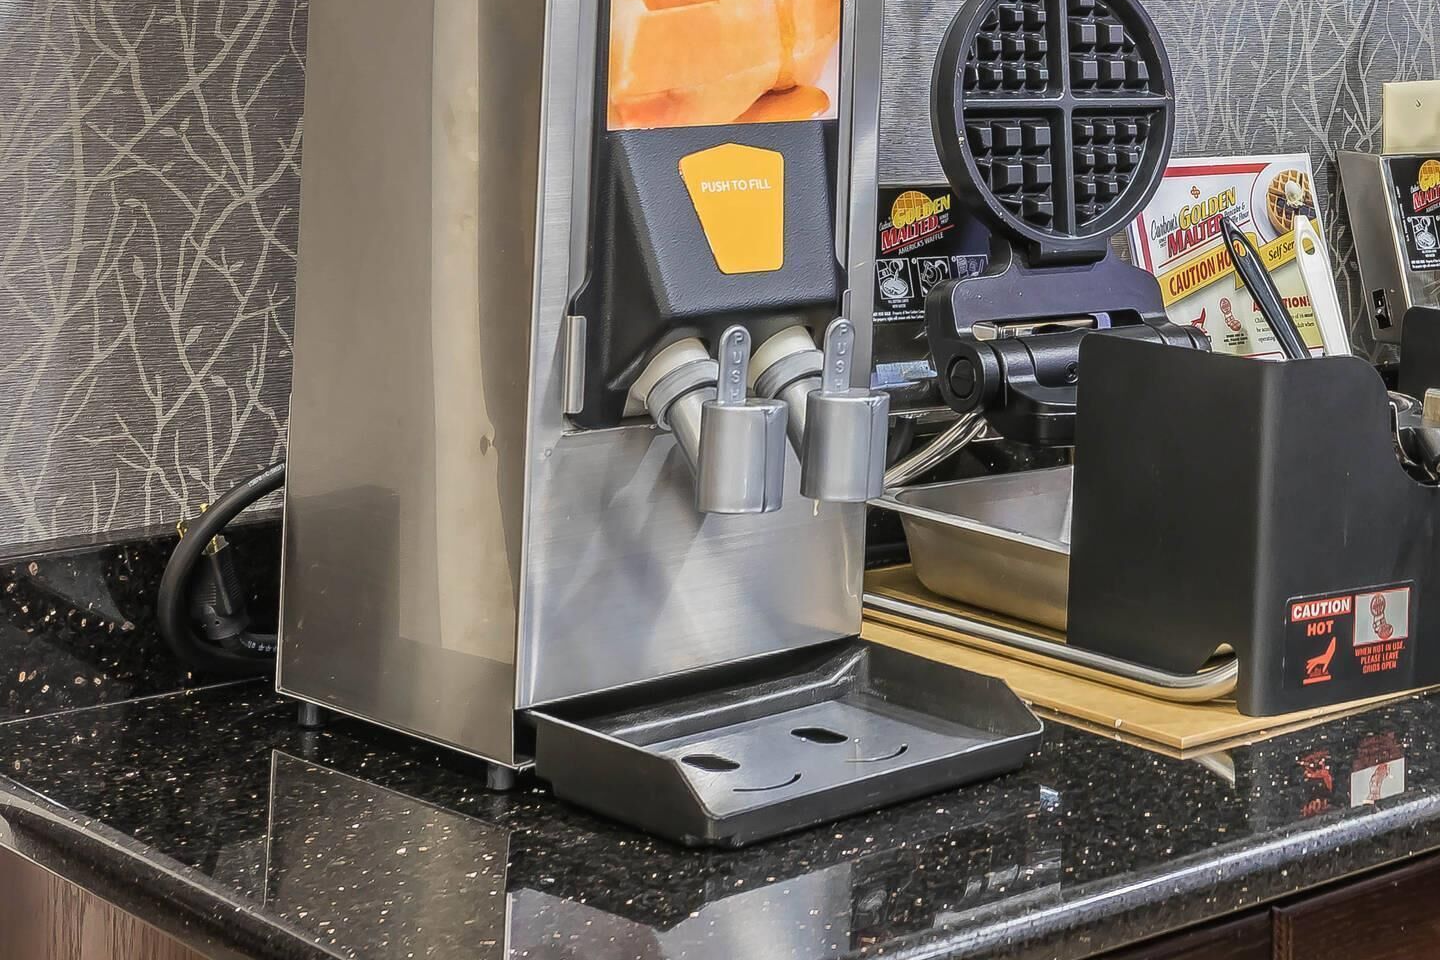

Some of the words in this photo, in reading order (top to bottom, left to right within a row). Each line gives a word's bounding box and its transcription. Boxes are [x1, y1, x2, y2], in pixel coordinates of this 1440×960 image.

[701, 180, 730, 193] PUSH
[731, 179, 747, 191] TO
[748, 178, 772, 190] FILL
[893, 193, 951, 229] GOLDEN
[1178, 186, 1236, 231] GOLDEN
[881, 215, 939, 251] MALTED
[1268, 243, 1283, 262] Self
[1169, 256, 1216, 297] CAUTION
[1293, 598, 1350, 619] CAUTION
[1307, 620, 1335, 637] HOT
[1360, 652, 1381, 665] PLEASE
[1382, 650, 1399, 661] LEAVE
[1372, 643, 1384, 654] NOT
[1381, 661, 1397, 671] OPEN
